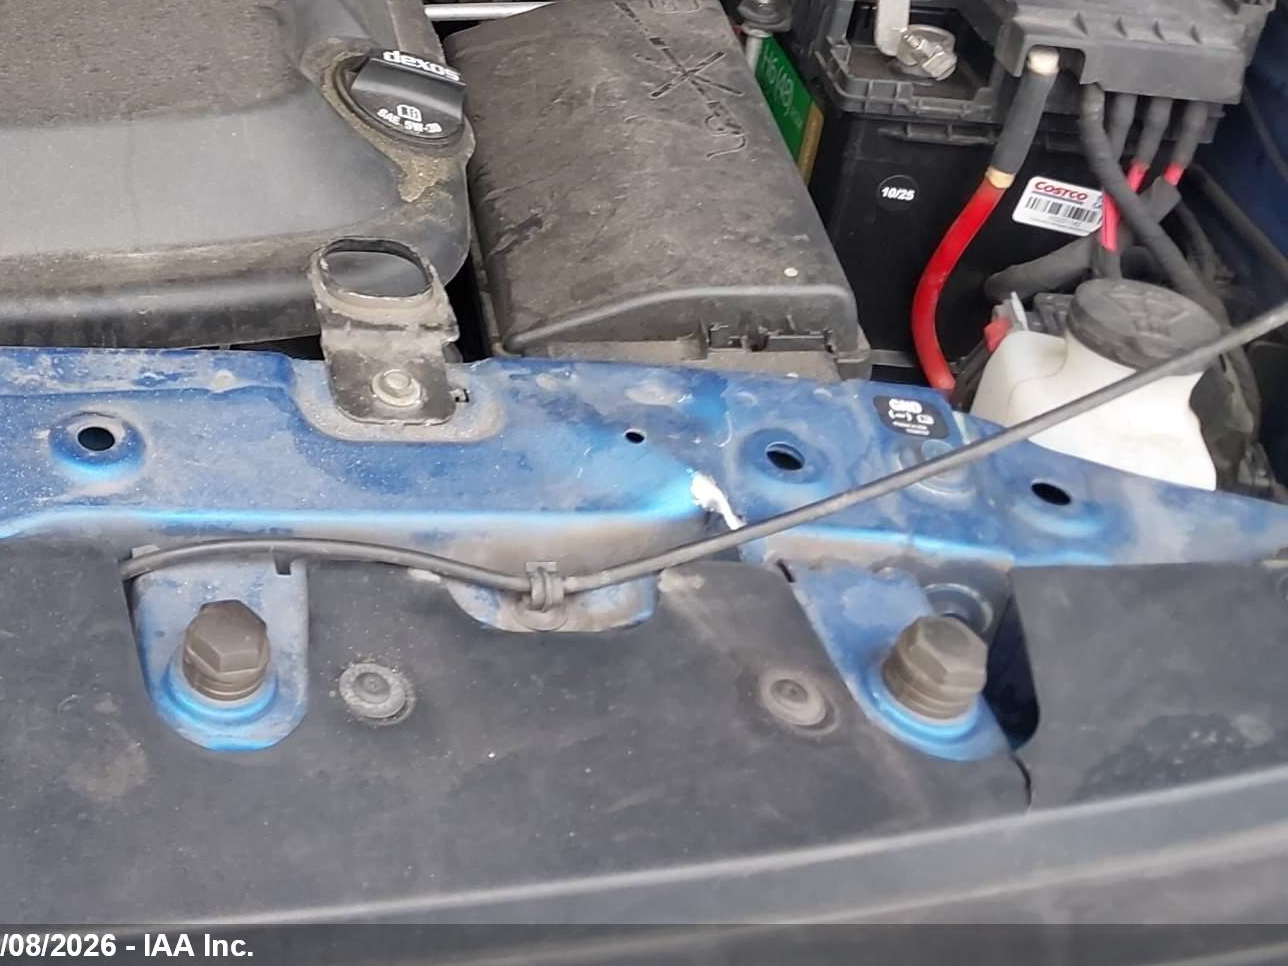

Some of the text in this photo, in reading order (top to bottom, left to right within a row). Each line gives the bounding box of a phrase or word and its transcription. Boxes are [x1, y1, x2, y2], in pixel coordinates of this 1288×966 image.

[382, 50, 461, 82] dexos
[880, 186, 915, 202] 10/25
[1034, 181, 1088, 202] COSTCO
